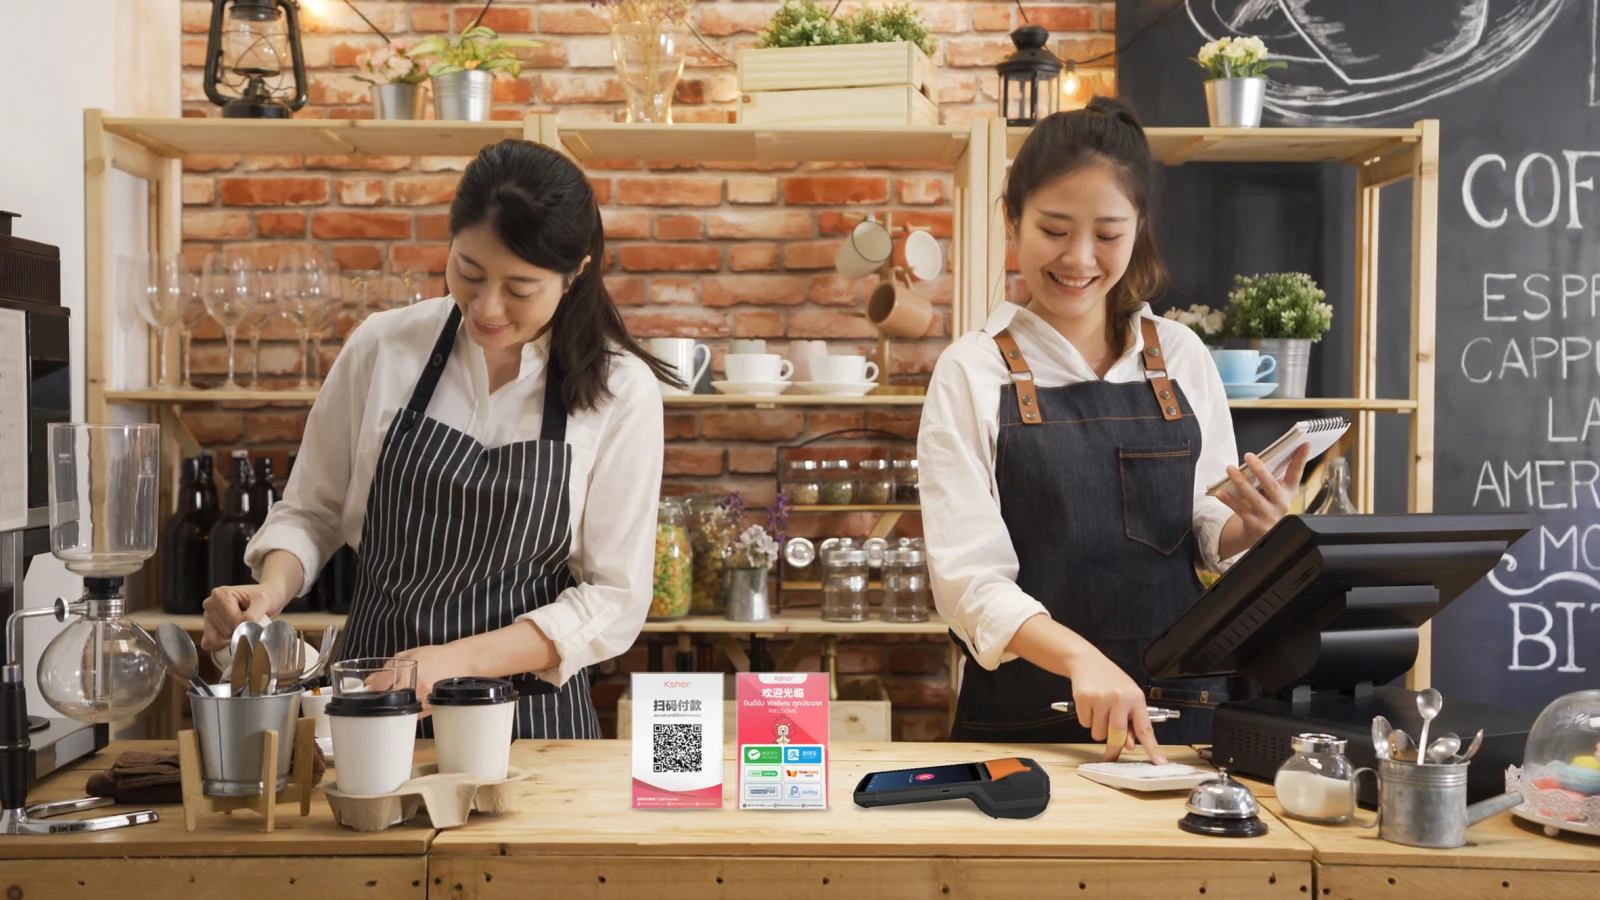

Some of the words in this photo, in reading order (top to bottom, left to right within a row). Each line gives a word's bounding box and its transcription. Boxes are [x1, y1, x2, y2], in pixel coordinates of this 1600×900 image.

[1461, 149, 1600, 229] COF
[1461, 336, 1600, 384] CAPP
[1547, 396, 1600, 442] LA
[1472, 460, 1600, 509] AMER
[1507, 602, 1600, 673] BI
[654, 700, 702, 712] 扫码付款
[762, 688, 804, 698] 欢迎光临
